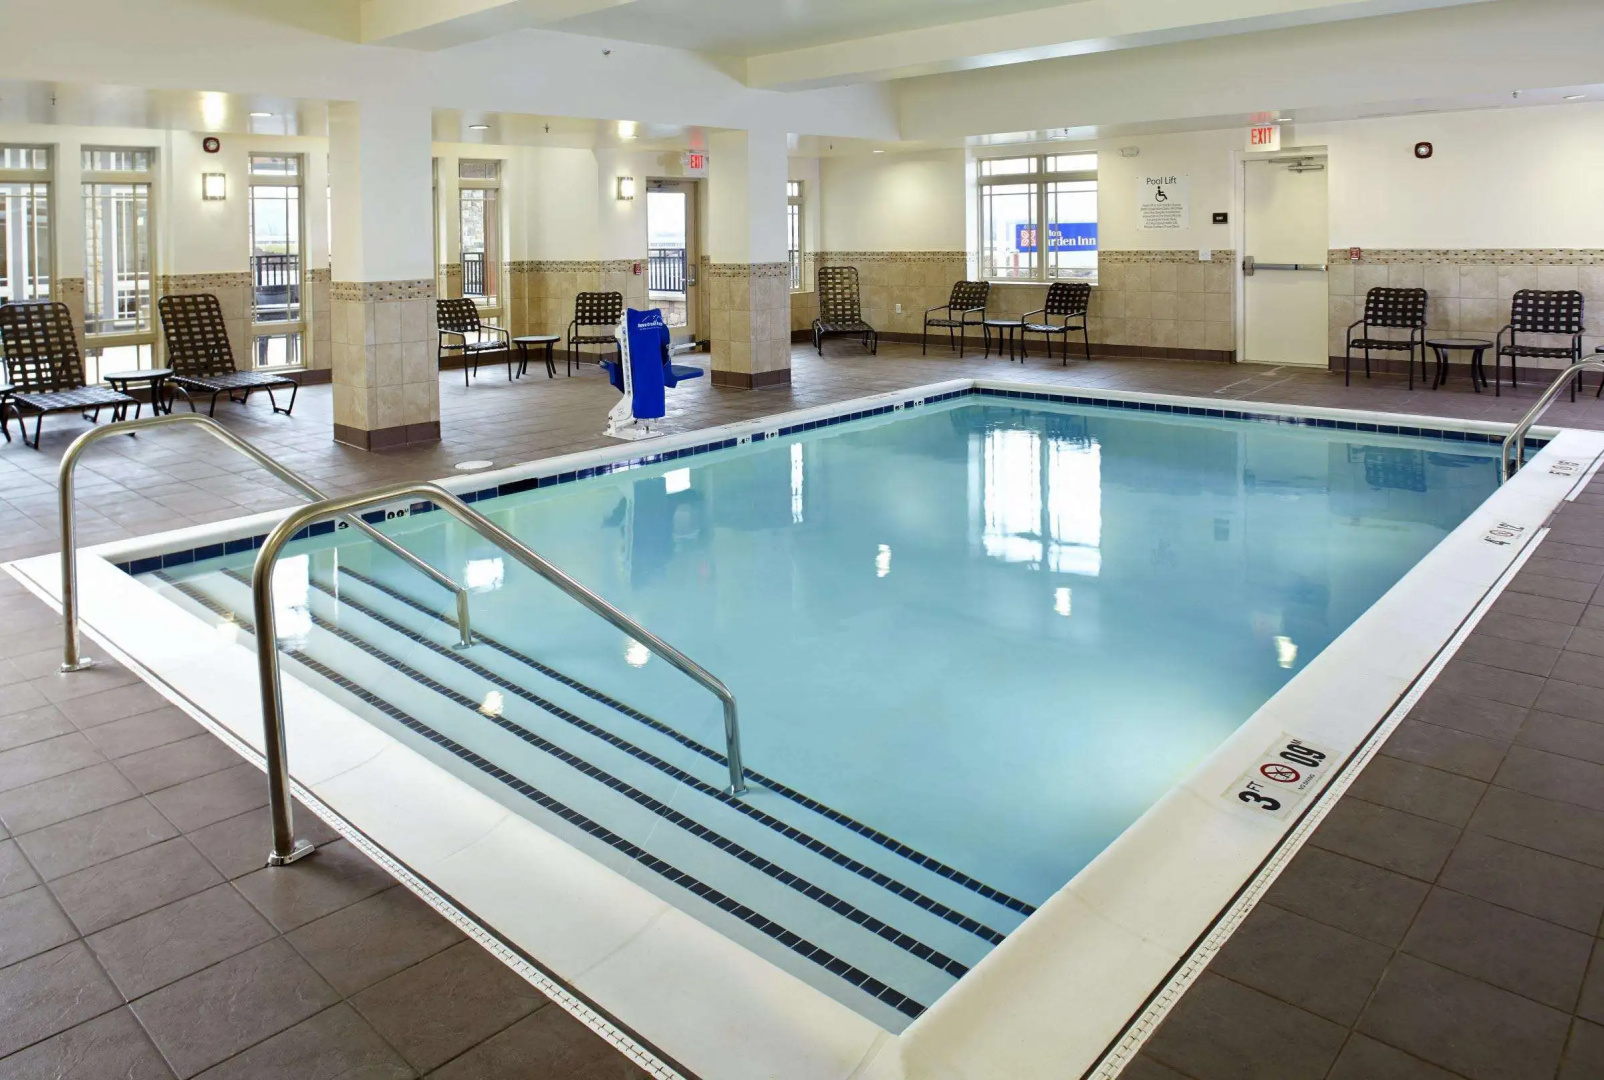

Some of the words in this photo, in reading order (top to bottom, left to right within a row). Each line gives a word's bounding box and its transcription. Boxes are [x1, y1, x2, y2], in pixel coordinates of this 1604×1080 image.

[1251, 128, 1272, 144] EXIT
[691, 155, 703, 168] EXIT
[1147, 177, 1162, 185] Pool
[1165, 176, 1177, 184] Lift
[1078, 236, 1096, 246] Inn
[1238, 790, 1281, 811] 3
